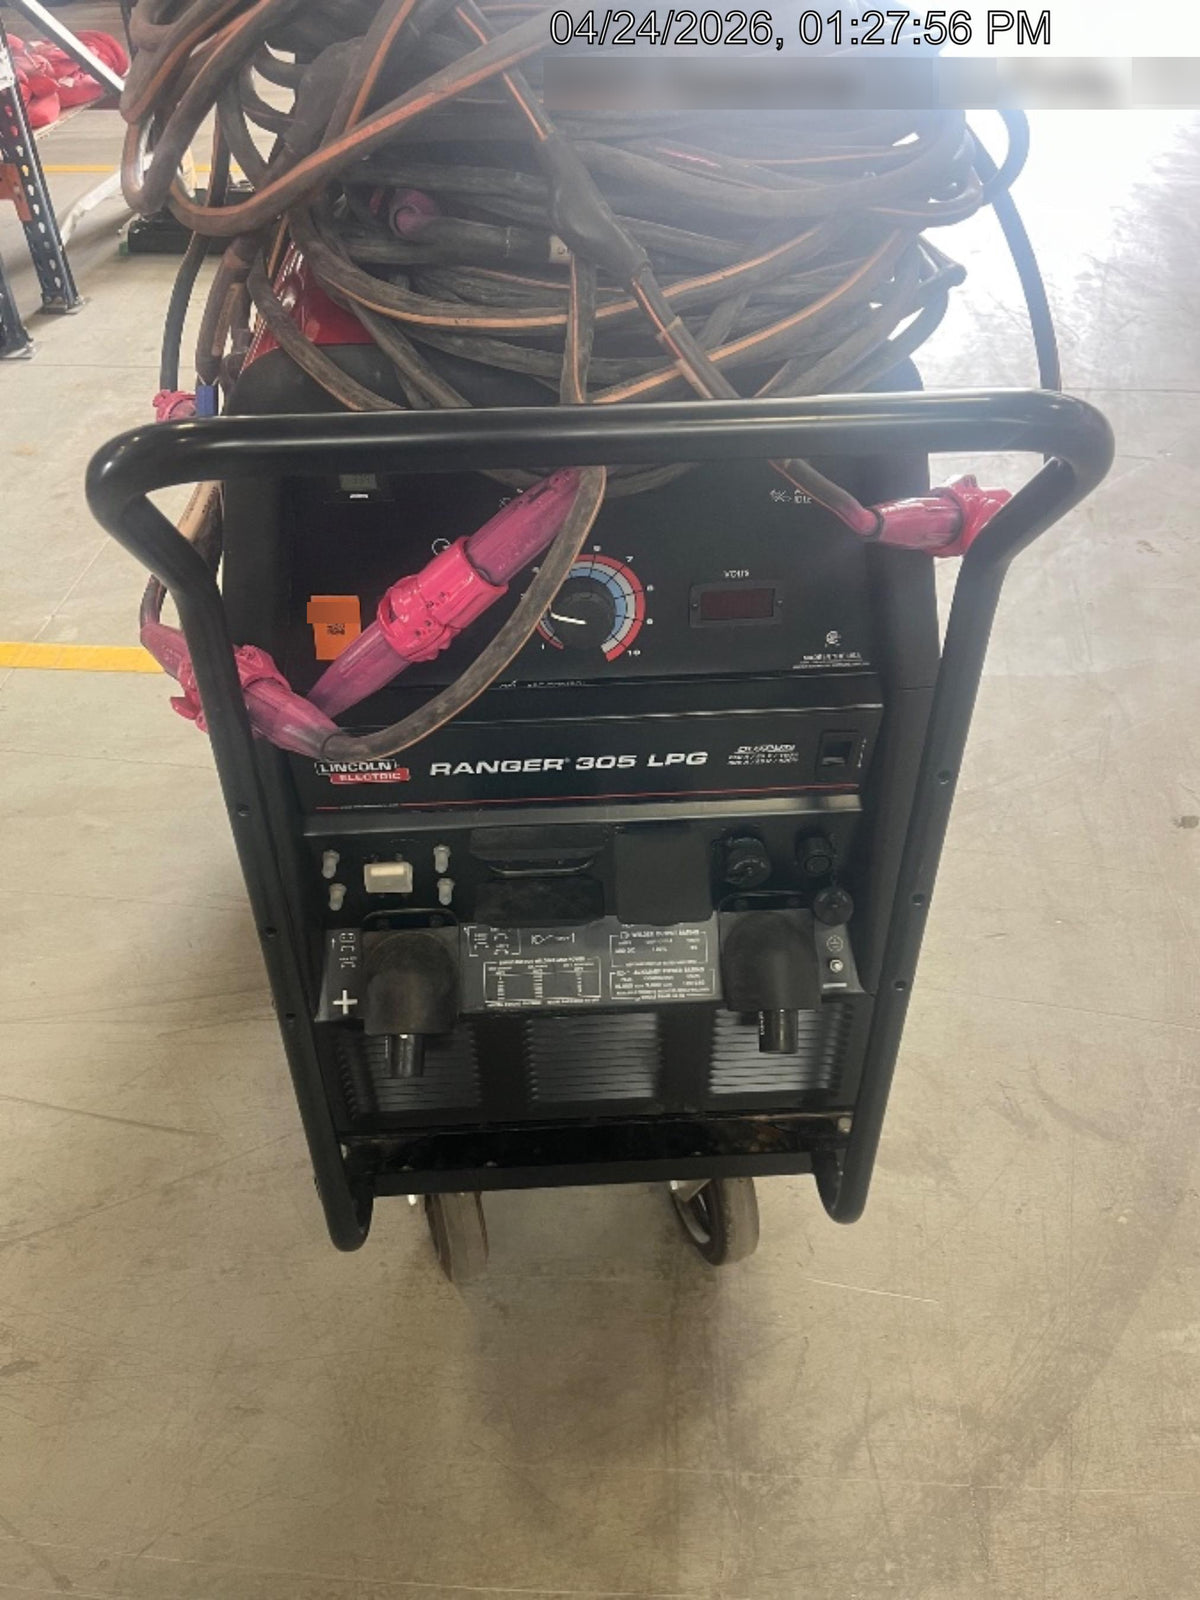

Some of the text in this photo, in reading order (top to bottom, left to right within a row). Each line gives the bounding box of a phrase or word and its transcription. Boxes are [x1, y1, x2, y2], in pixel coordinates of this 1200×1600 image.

[320, 761, 390, 773] LINCOLN
[575, 753, 638, 770] 305
[647, 751, 709, 767] LPG
